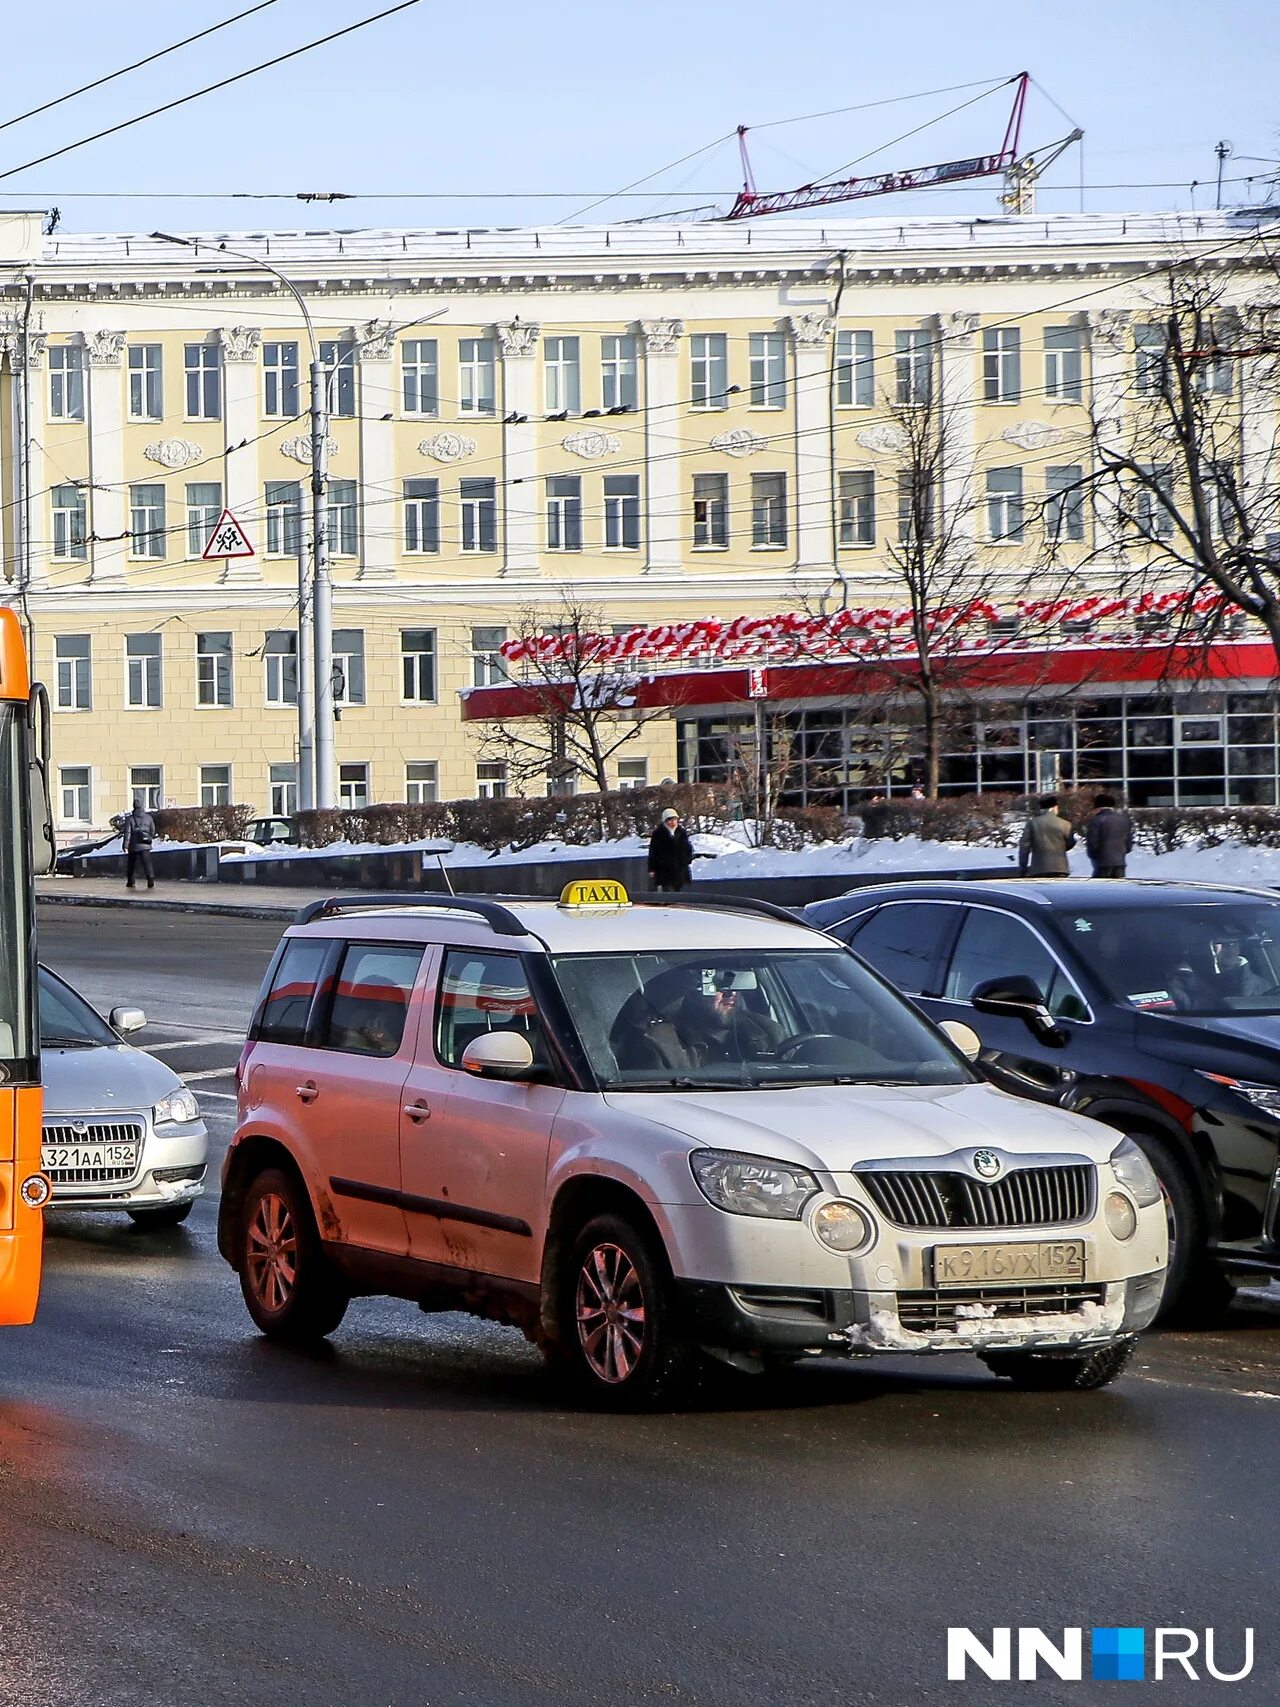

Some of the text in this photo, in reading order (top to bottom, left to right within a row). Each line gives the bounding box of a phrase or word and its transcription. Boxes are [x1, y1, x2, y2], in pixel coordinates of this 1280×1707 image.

[575, 885, 621, 902] TAXI
[106, 1146, 131, 1160] 152
[1042, 1244, 1078, 1266] 152
